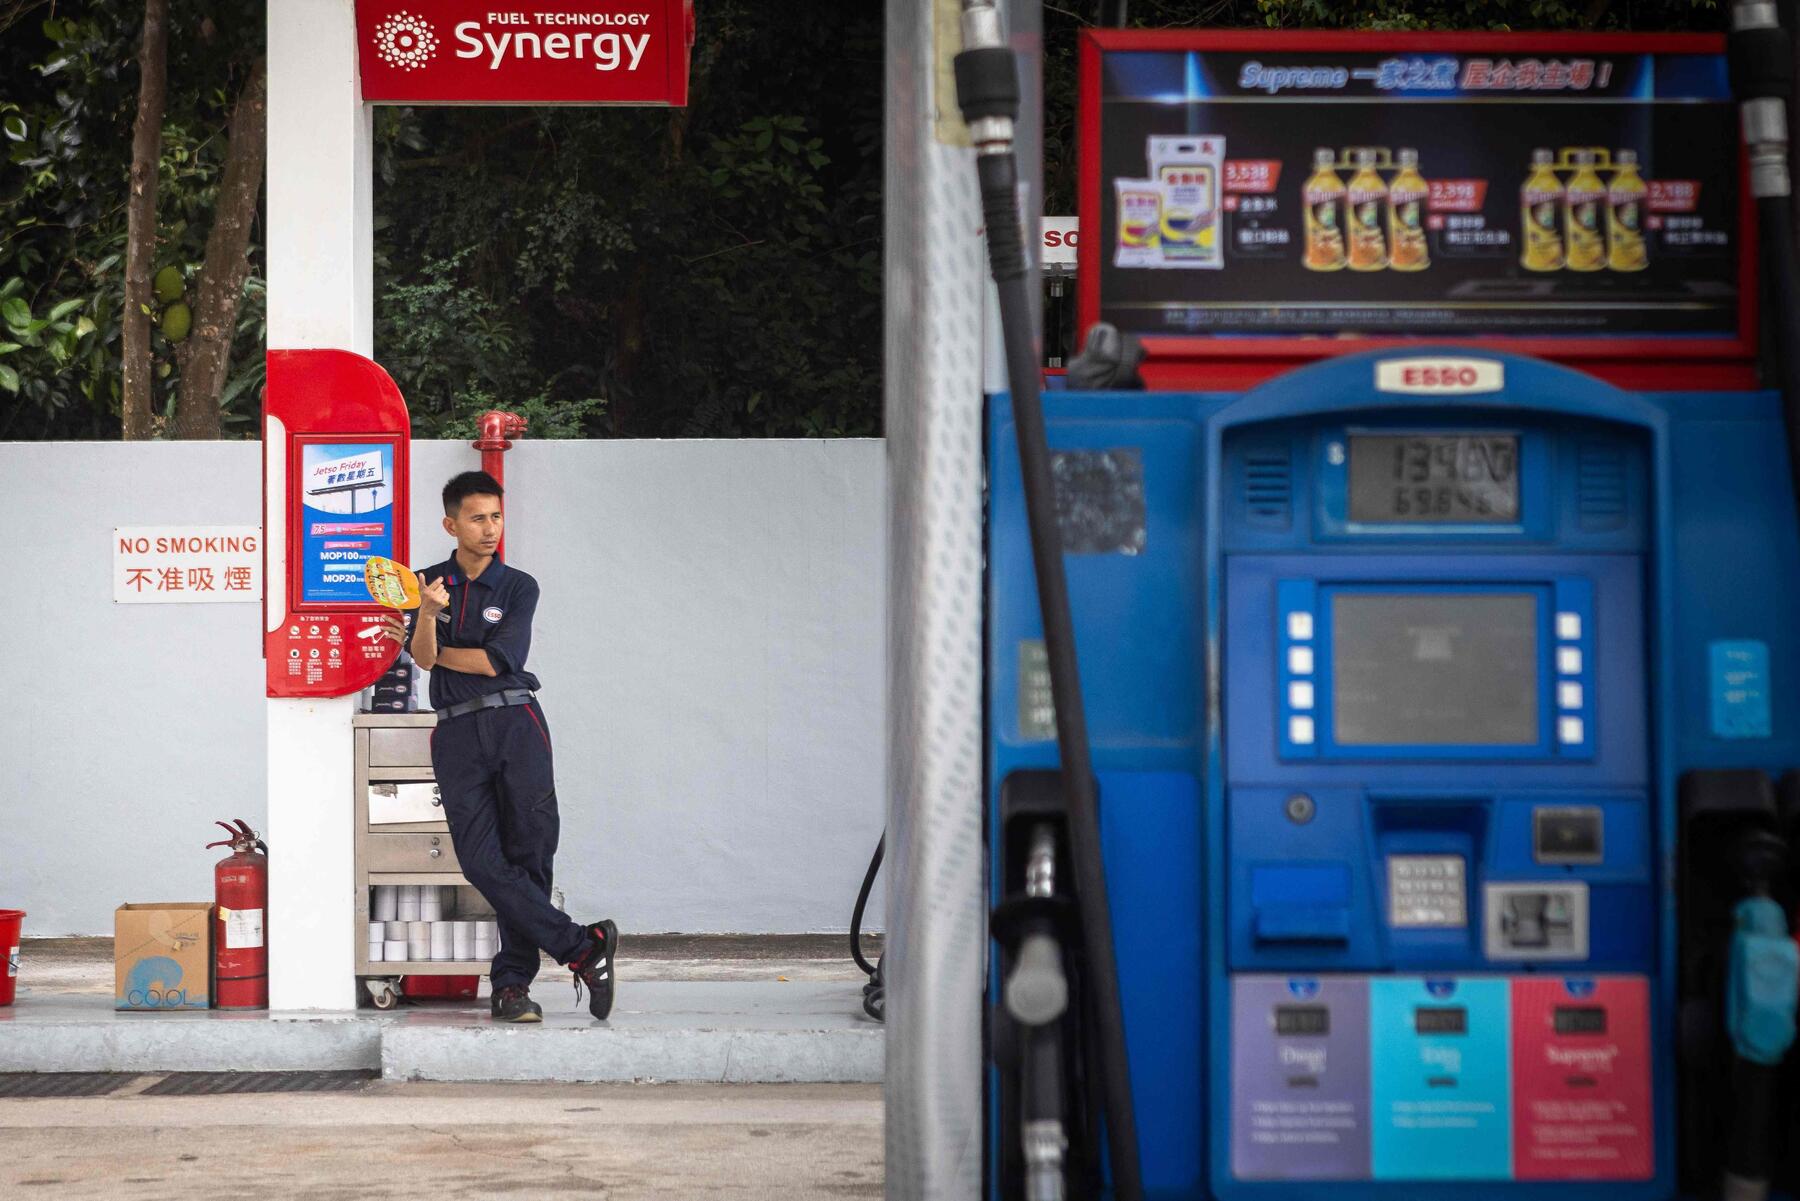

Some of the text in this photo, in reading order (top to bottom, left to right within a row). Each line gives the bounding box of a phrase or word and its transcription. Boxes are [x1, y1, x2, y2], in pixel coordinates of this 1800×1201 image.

[487, 12, 650, 26] FUEL TECHNOLOGY
[454, 21, 651, 71] Synergy
[1239, 60, 1349, 94] Supreme
[339, 460, 368, 471] Friday
[120, 536, 257, 554] NO SMOKING
[320, 552, 359, 560] MOP100
[126, 566, 253, 593] 不准吸煙
[323, 574, 357, 583] MOP20
